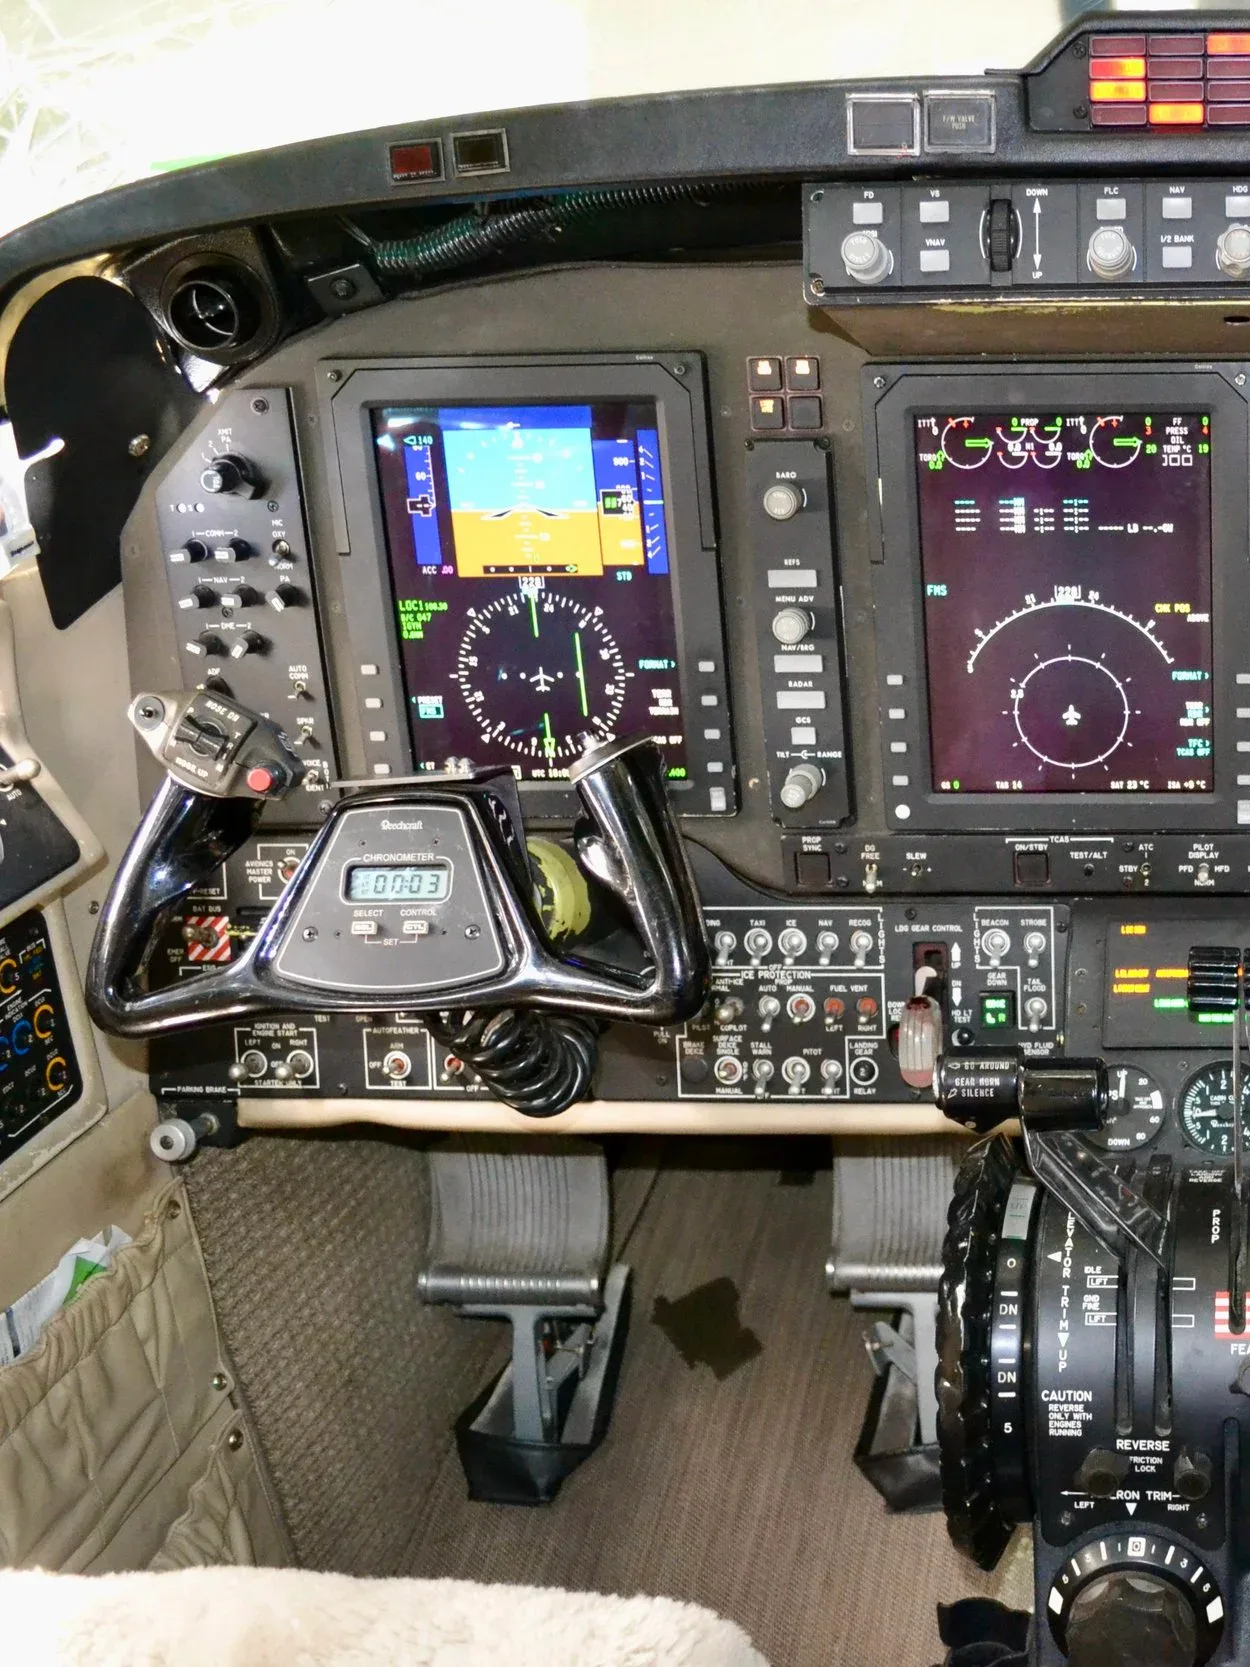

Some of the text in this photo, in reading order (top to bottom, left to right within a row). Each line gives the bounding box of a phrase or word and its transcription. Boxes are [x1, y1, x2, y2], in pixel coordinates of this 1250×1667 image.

[1026, 188, 1048, 197] DOWN
[1170, 186, 1185, 194] NAV
[1233, 185, 1248, 193] HDG
[864, 191, 874, 199] FD
[926, 238, 945, 246] VNAV
[1032, 271, 1043, 279] UP
[1021, 418, 1039, 426] PROP
[1166, 427, 1188, 435] PRESS
[1170, 436, 1184, 444] OIL
[272, 530, 285, 538] OXY
[280, 575, 290, 583] PA
[617, 571, 632, 580] STD
[213, 576, 228, 584] NAV
[639, 659, 668, 669] FORMAT
[289, 672, 308, 680] COMM
[1049, 835, 1069, 844] TCAS
[1138, 843, 1154, 851] ATC
[1193, 843, 1214, 851] PILOT
[363, 853, 434, 862] CHRONOMETER
[906, 852, 926, 860] SLEW
[1188, 851, 1219, 859] DISPLAY
[245, 860, 273, 868] AVIONICS
[247, 868, 273, 876] MASTER
[1119, 865, 1138, 873] STBY
[1178, 865, 1194, 873] PFD
[741, 971, 811, 979] ICE PROTECTION
[390, 1080, 406, 1088] TEST
[1138, 1078, 1148, 1086] 20
[961, 1089, 994, 1097] SILENCE
[1108, 1138, 1130, 1146] DOWN
[998, 1372, 1016, 1383] DN
[1041, 1390, 1092, 1401] CAUTION
[1049, 1404, 1084, 1412] REVERSE
[1049, 1412, 1092, 1420] ONLY WITH
[1116, 1440, 1170, 1451] REVERSE
[1074, 1501, 1094, 1509] LEFT
[1167, 1504, 1190, 1512] RIGHT
